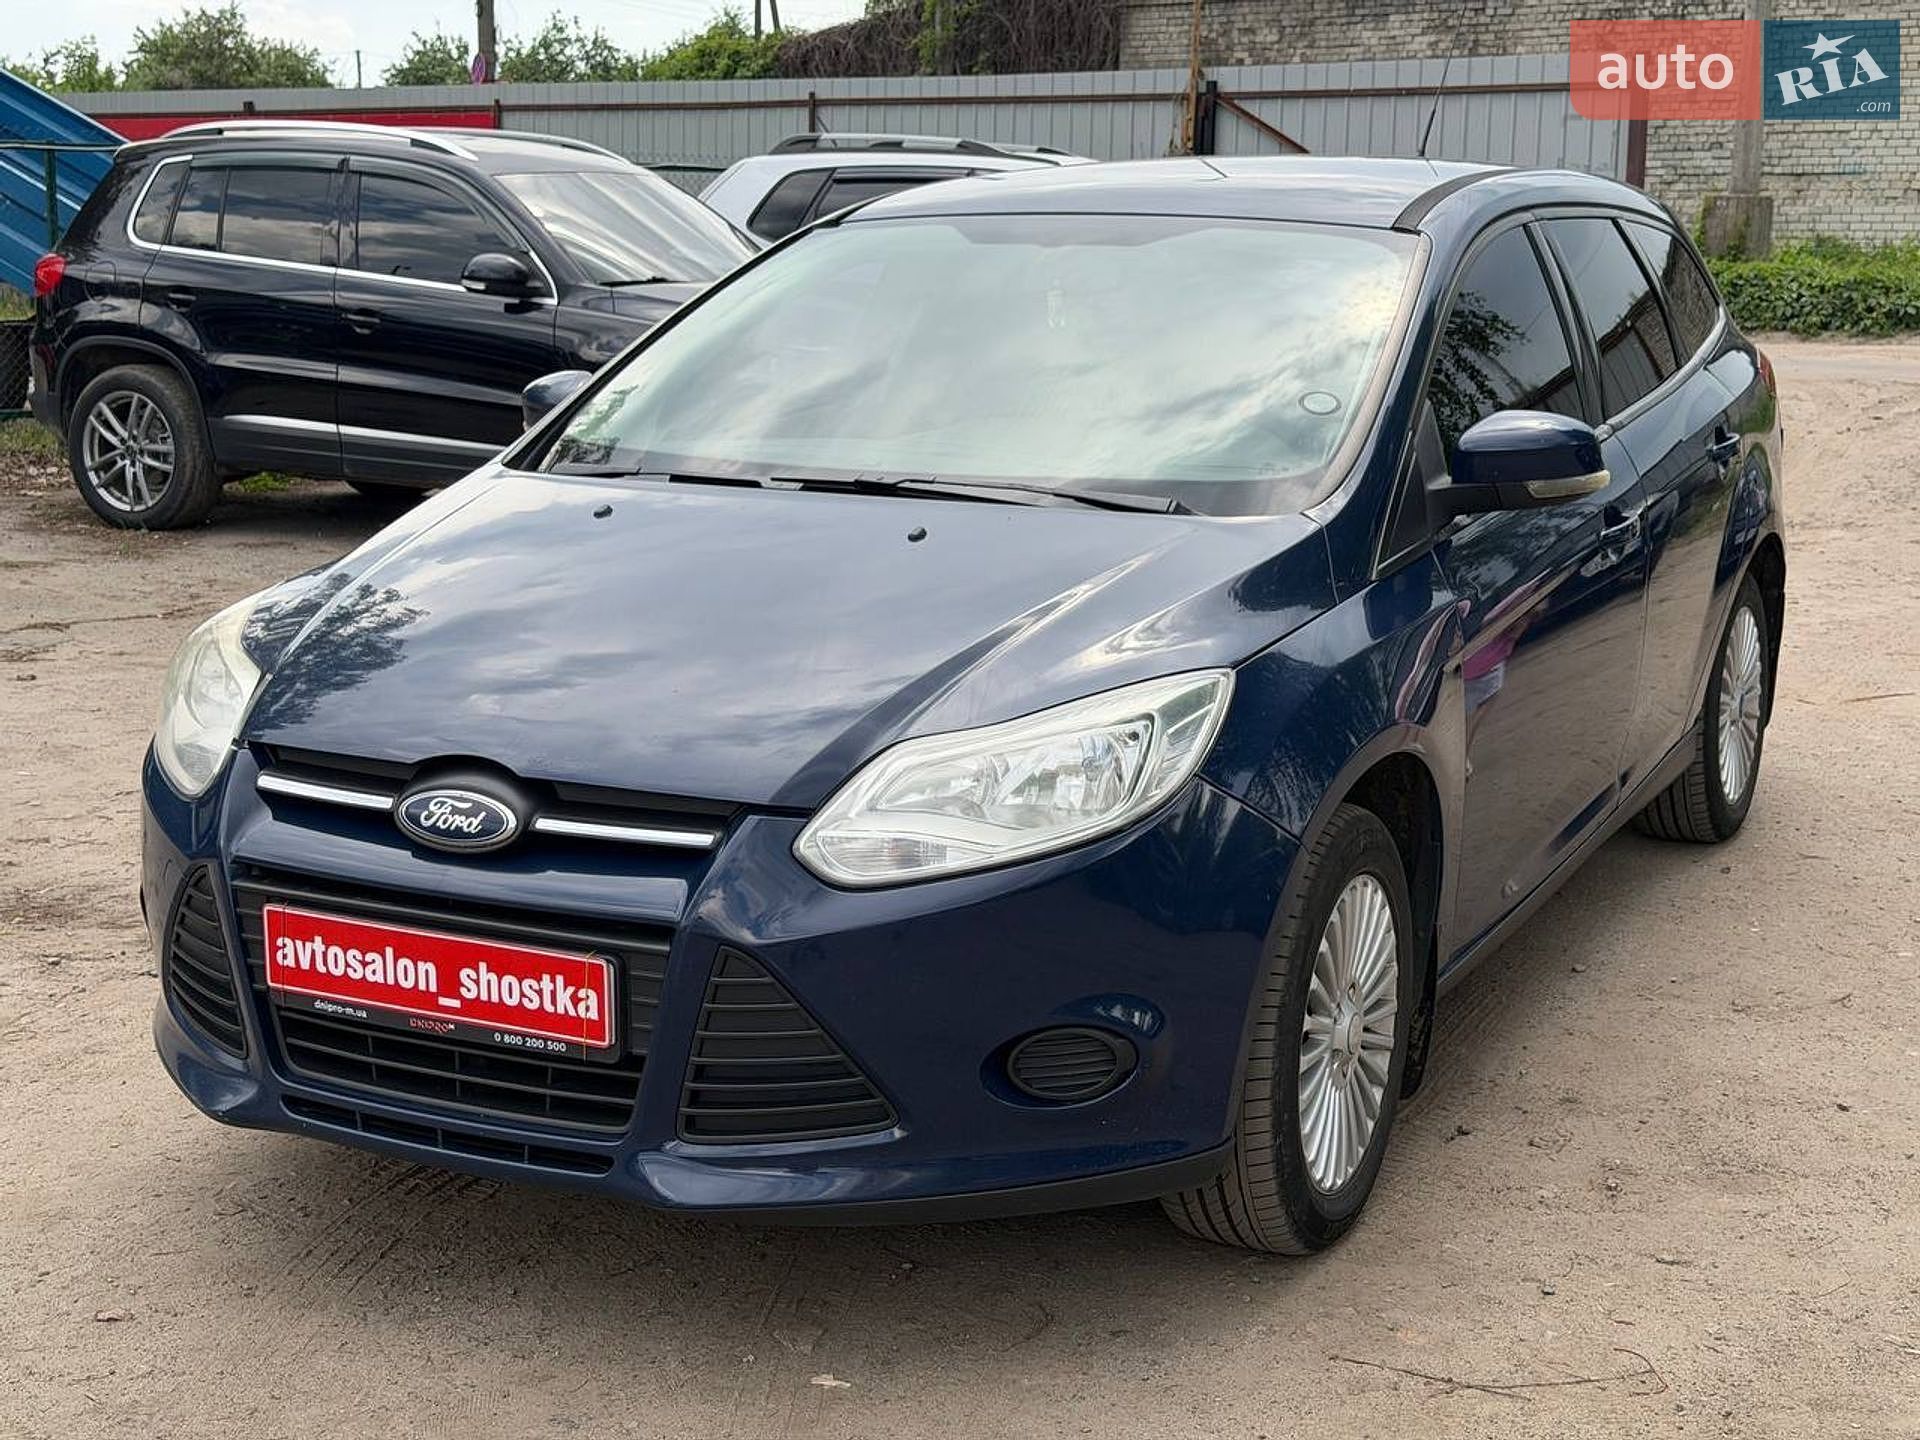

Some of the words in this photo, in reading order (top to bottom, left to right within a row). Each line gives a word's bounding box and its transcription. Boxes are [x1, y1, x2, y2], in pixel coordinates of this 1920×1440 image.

[420, 797, 487, 833] Ford
[275, 935, 600, 1021] avtosalon_shostka
[313, 999, 368, 1019] dnipro-m.ua
[493, 1032, 502, 1042] 0
[503, 1033, 523, 1046] 800
[525, 1037, 545, 1049] 200
[547, 1040, 567, 1052] 500
